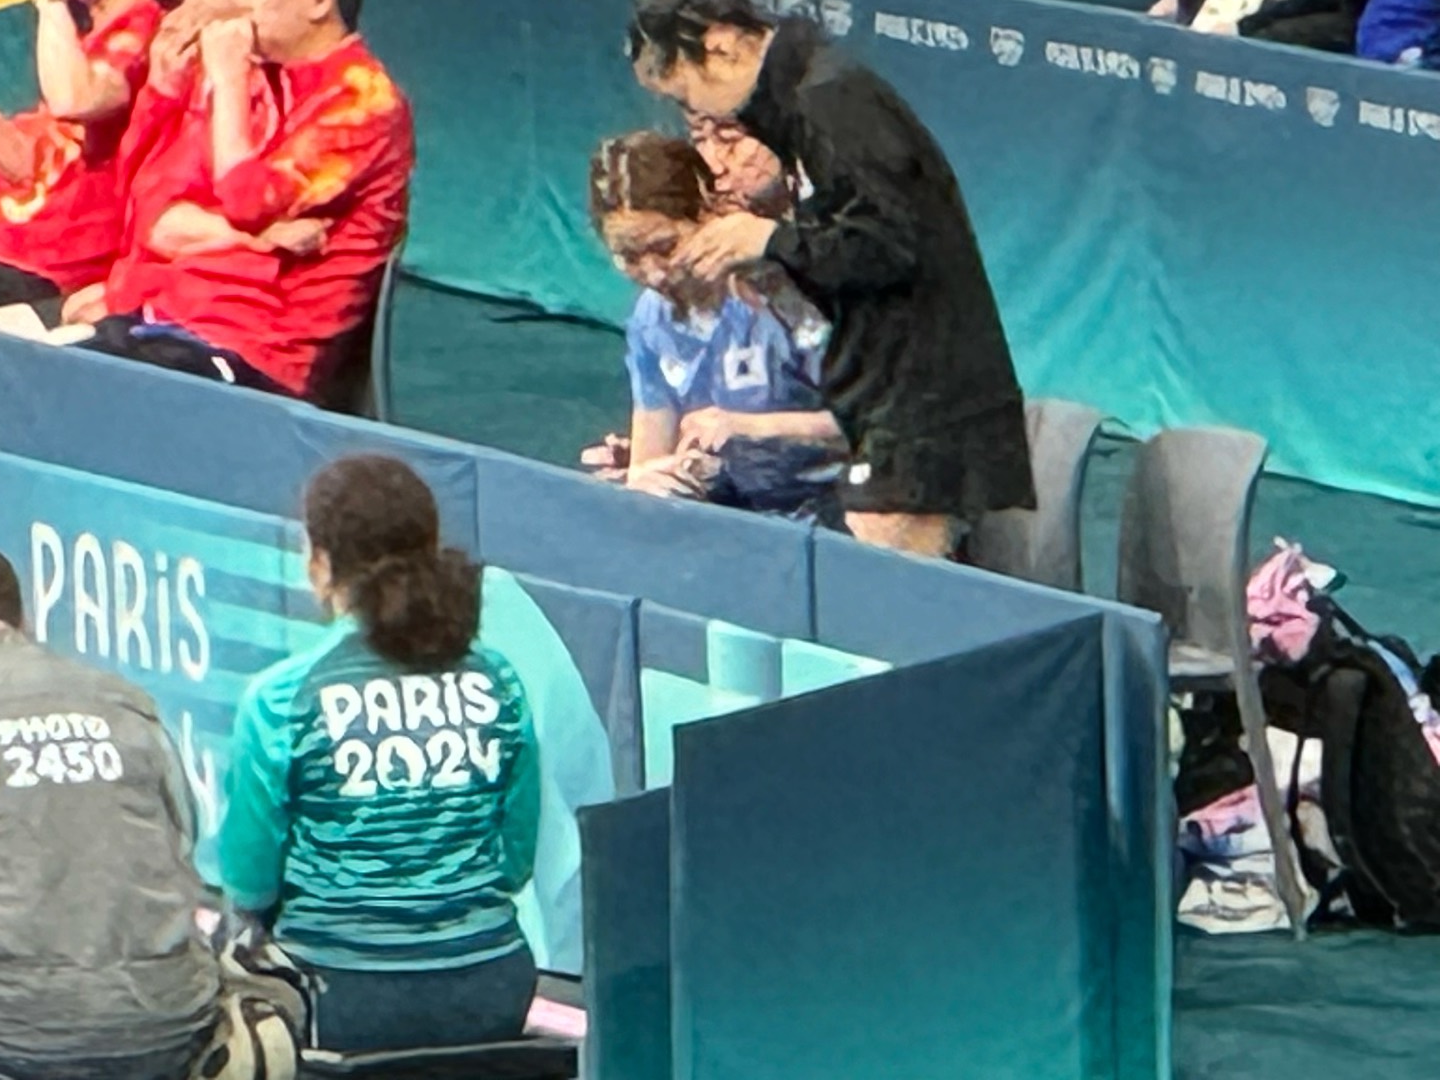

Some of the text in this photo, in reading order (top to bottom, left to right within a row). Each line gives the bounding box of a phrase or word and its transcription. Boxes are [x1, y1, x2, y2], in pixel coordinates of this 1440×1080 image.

[320, 671, 500, 742] PARIS
[3, 740, 124, 788] 2450
[333, 728, 501, 798] 2024
